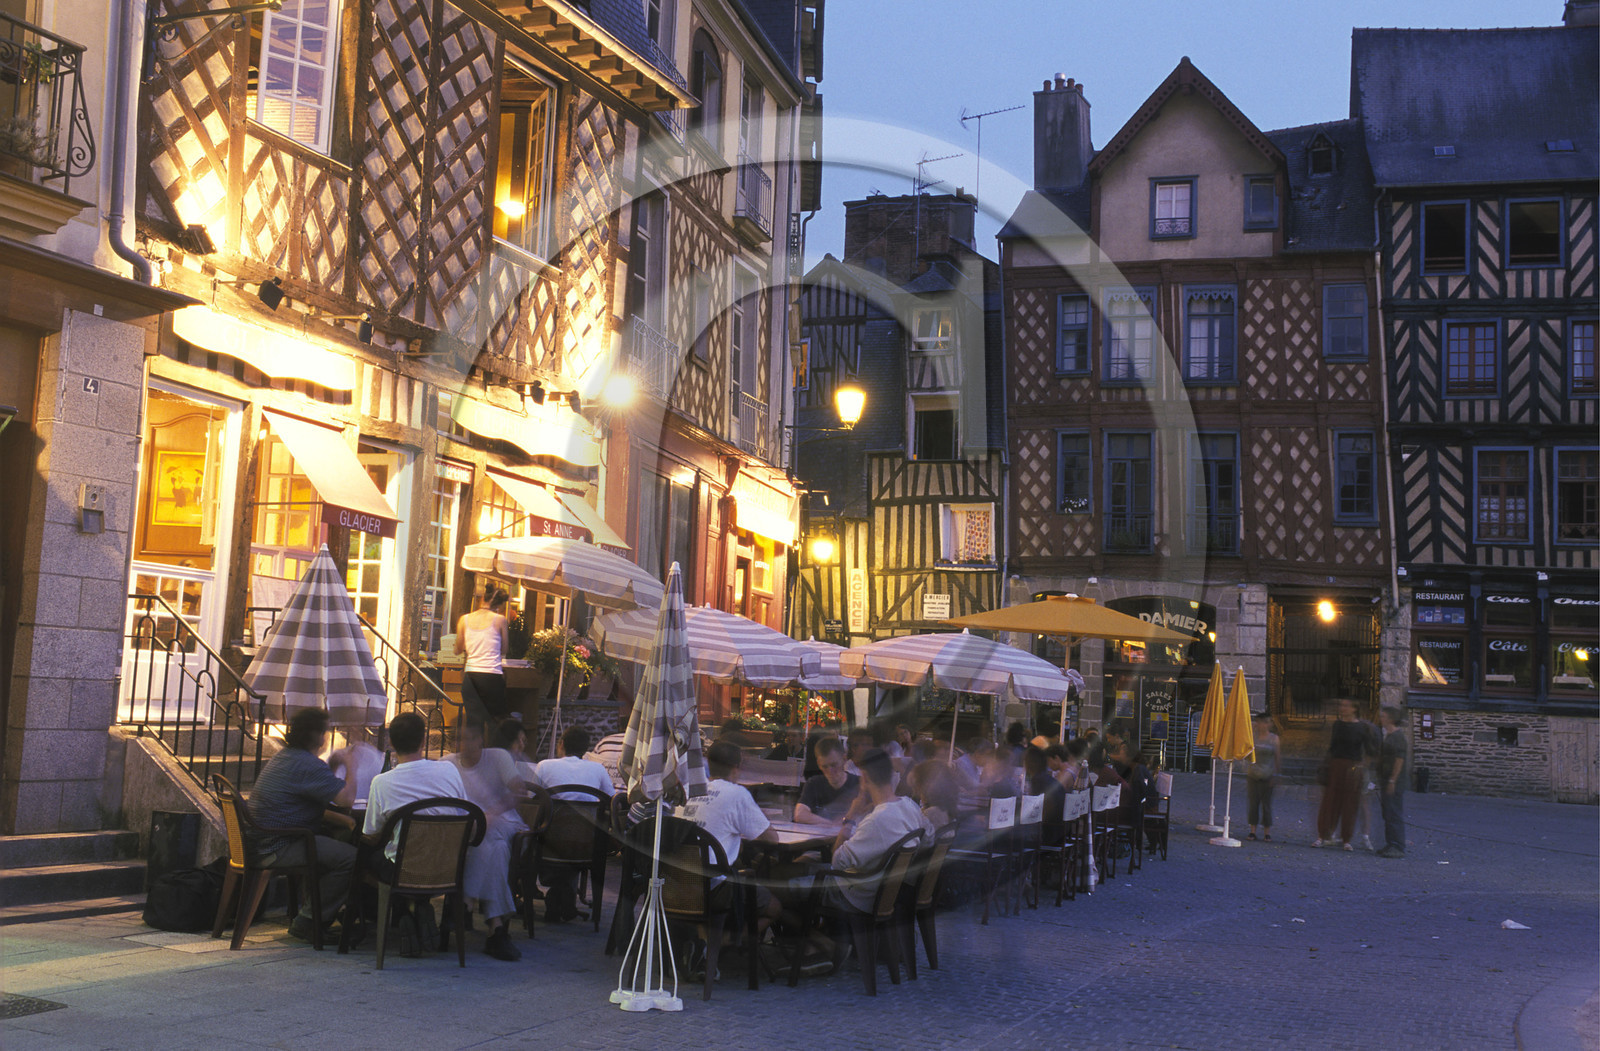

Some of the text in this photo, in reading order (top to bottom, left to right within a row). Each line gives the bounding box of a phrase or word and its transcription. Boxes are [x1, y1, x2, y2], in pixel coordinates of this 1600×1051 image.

[340, 509, 381, 534] GLACIER
[554, 523, 573, 539] ANNE
[851, 573, 863, 627] AGENCE
[1415, 592, 1465, 600] RESTAURANT
[1138, 612, 1208, 635] DAMIER
[1419, 641, 1461, 649] RESTAURANT
[1489, 640, 1528, 652] Côte
[1146, 690, 1173, 701] SALLES
